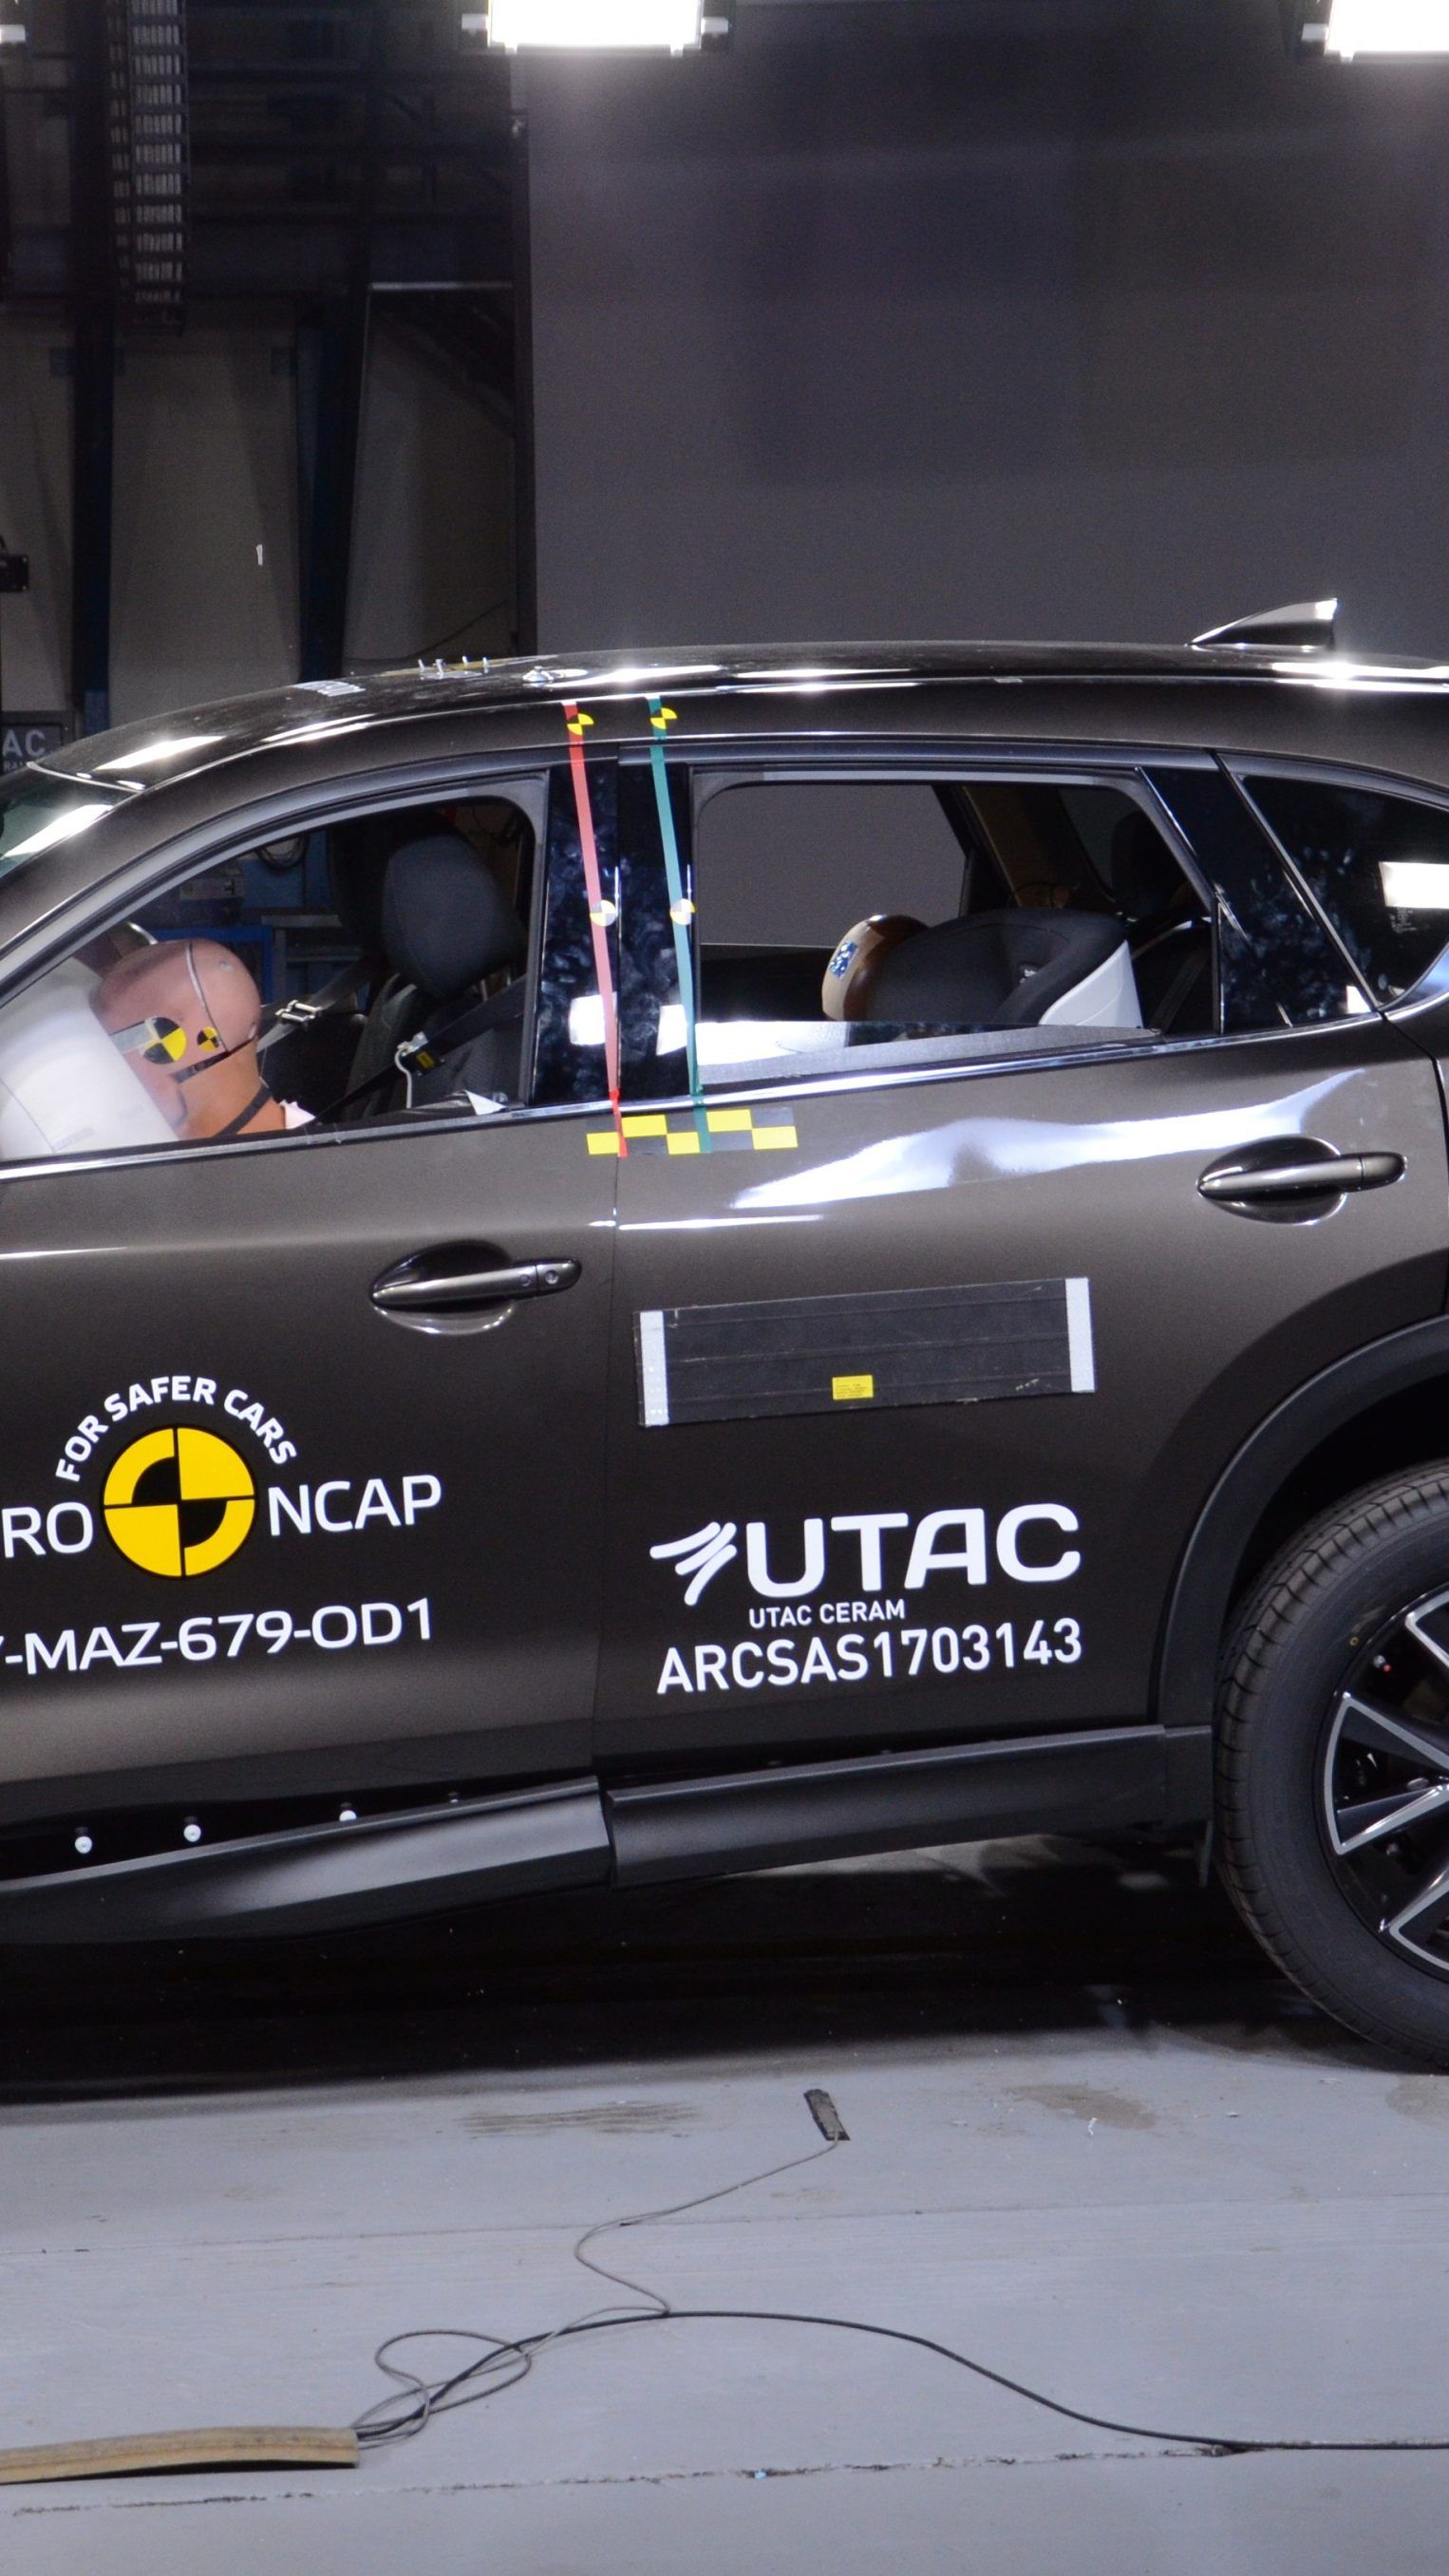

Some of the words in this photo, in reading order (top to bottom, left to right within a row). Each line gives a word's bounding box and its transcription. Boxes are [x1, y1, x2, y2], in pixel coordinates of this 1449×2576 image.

[55, 1415, 109, 1482] FOR
[104, 1375, 217, 1422] SAFER
[223, 1389, 297, 1465] CARS
[1, 1501, 94, 1558] RO
[268, 1474, 442, 1536] NCAP
[745, 1502, 1082, 1598] UTAC
[0, 1597, 433, 1675] -MAZ-679-OD1
[748, 1605, 812, 1629] UTAC
[819, 1598, 906, 1625] CERAM
[656, 1617, 1082, 1695] ARCSAS1703143
